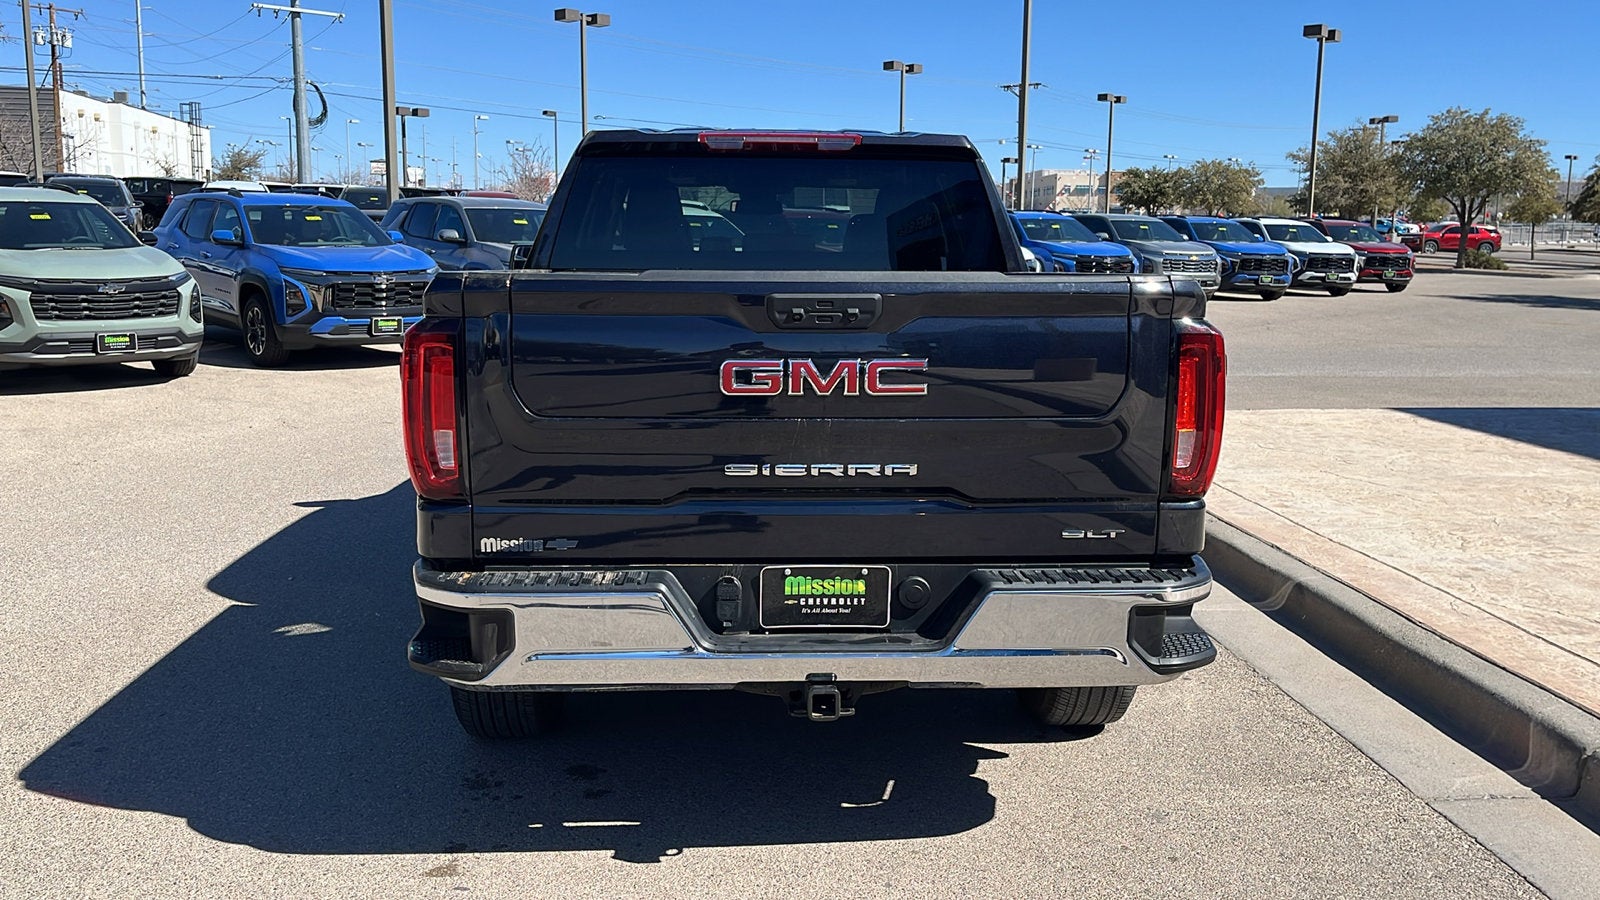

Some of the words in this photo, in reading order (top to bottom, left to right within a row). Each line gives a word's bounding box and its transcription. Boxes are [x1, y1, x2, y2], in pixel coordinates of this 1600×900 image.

[719, 358, 929, 396] GMC
[724, 463, 918, 477] SIERRA
[1062, 529, 1126, 539] SLT
[480, 537, 544, 553] Mission
[784, 575, 866, 596] Mission
[799, 597, 866, 606] CHEVROLET
